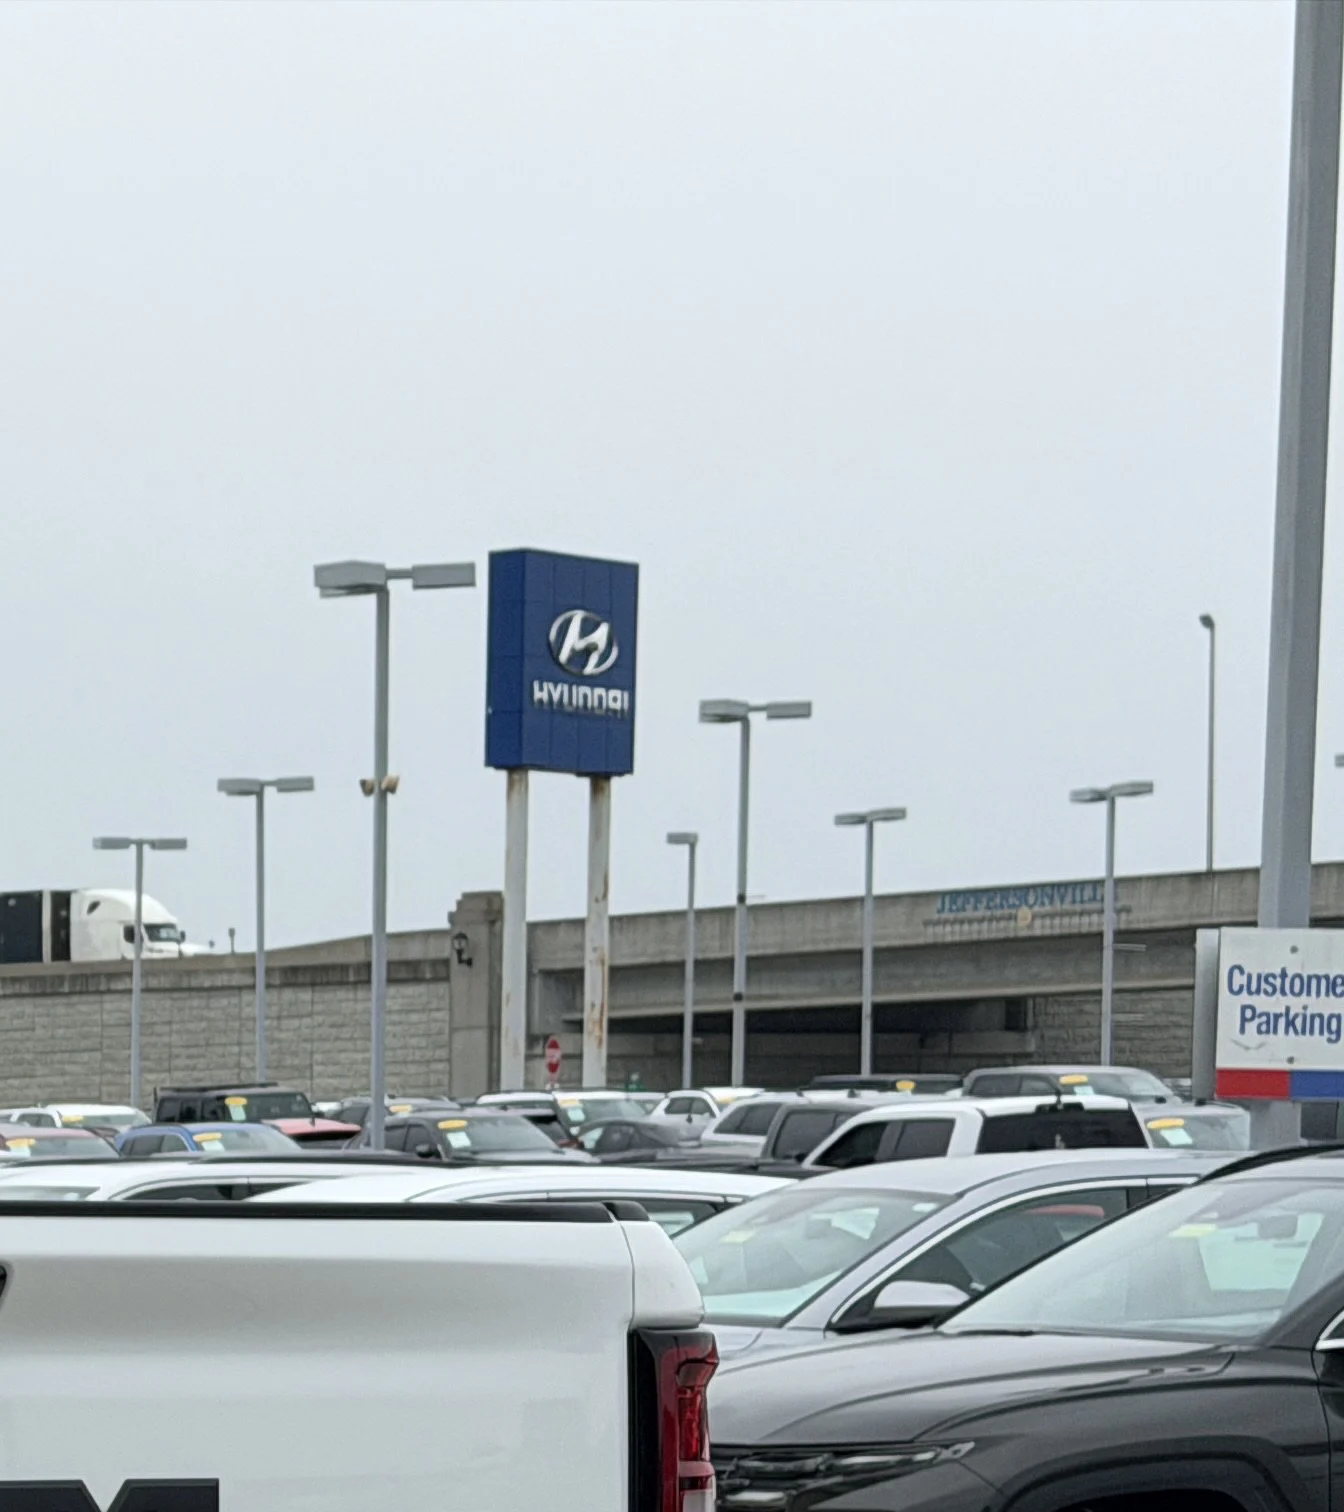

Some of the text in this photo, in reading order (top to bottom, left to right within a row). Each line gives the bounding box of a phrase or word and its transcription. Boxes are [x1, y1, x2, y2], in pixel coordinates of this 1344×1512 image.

[533, 679, 629, 711] HYUNDAI
[936, 881, 1105, 914] JEFFERSONVILL
[1239, 1004, 1341, 1044] Parking
